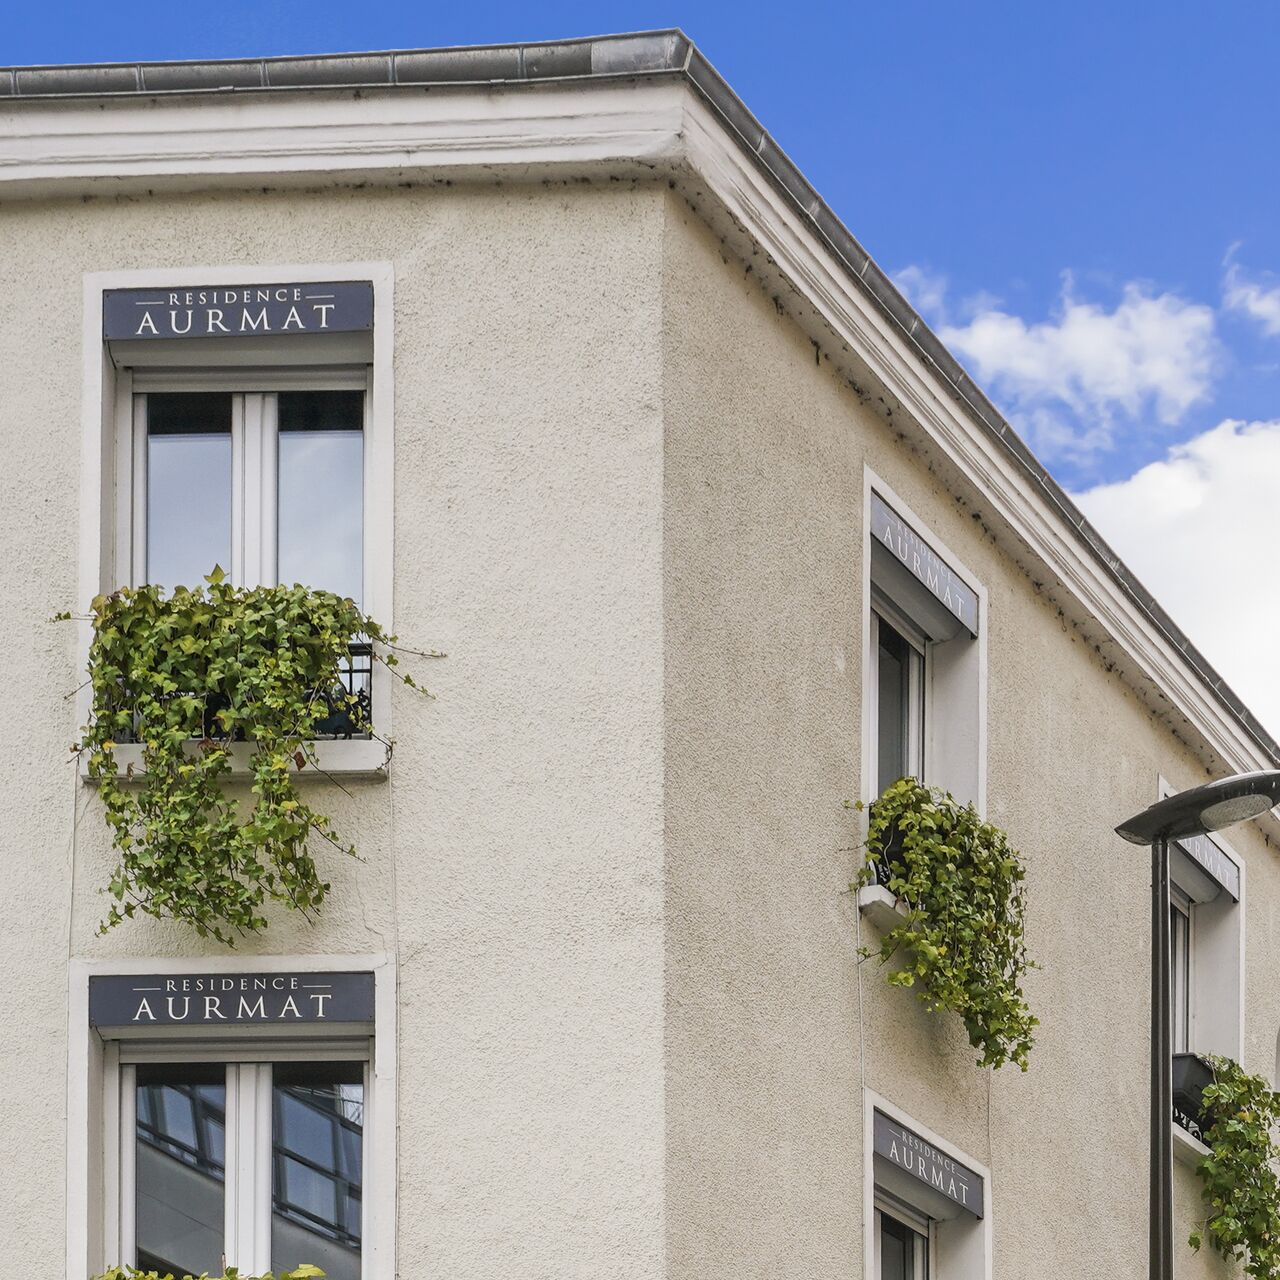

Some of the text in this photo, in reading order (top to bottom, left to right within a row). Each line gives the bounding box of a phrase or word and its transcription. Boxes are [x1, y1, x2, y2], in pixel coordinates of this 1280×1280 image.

[169, 288, 302, 306] RESIDENCE
[135, 304, 335, 335] AURMAT
[896, 519, 951, 582] RESIDENCE
[884, 525, 965, 617] AURMAT
[166, 977, 299, 992] RESIDENCE
[132, 994, 332, 1021] AURMAT
[902, 1131, 956, 1174] RESIDENCE
[889, 1140, 969, 1205] AURMAT
